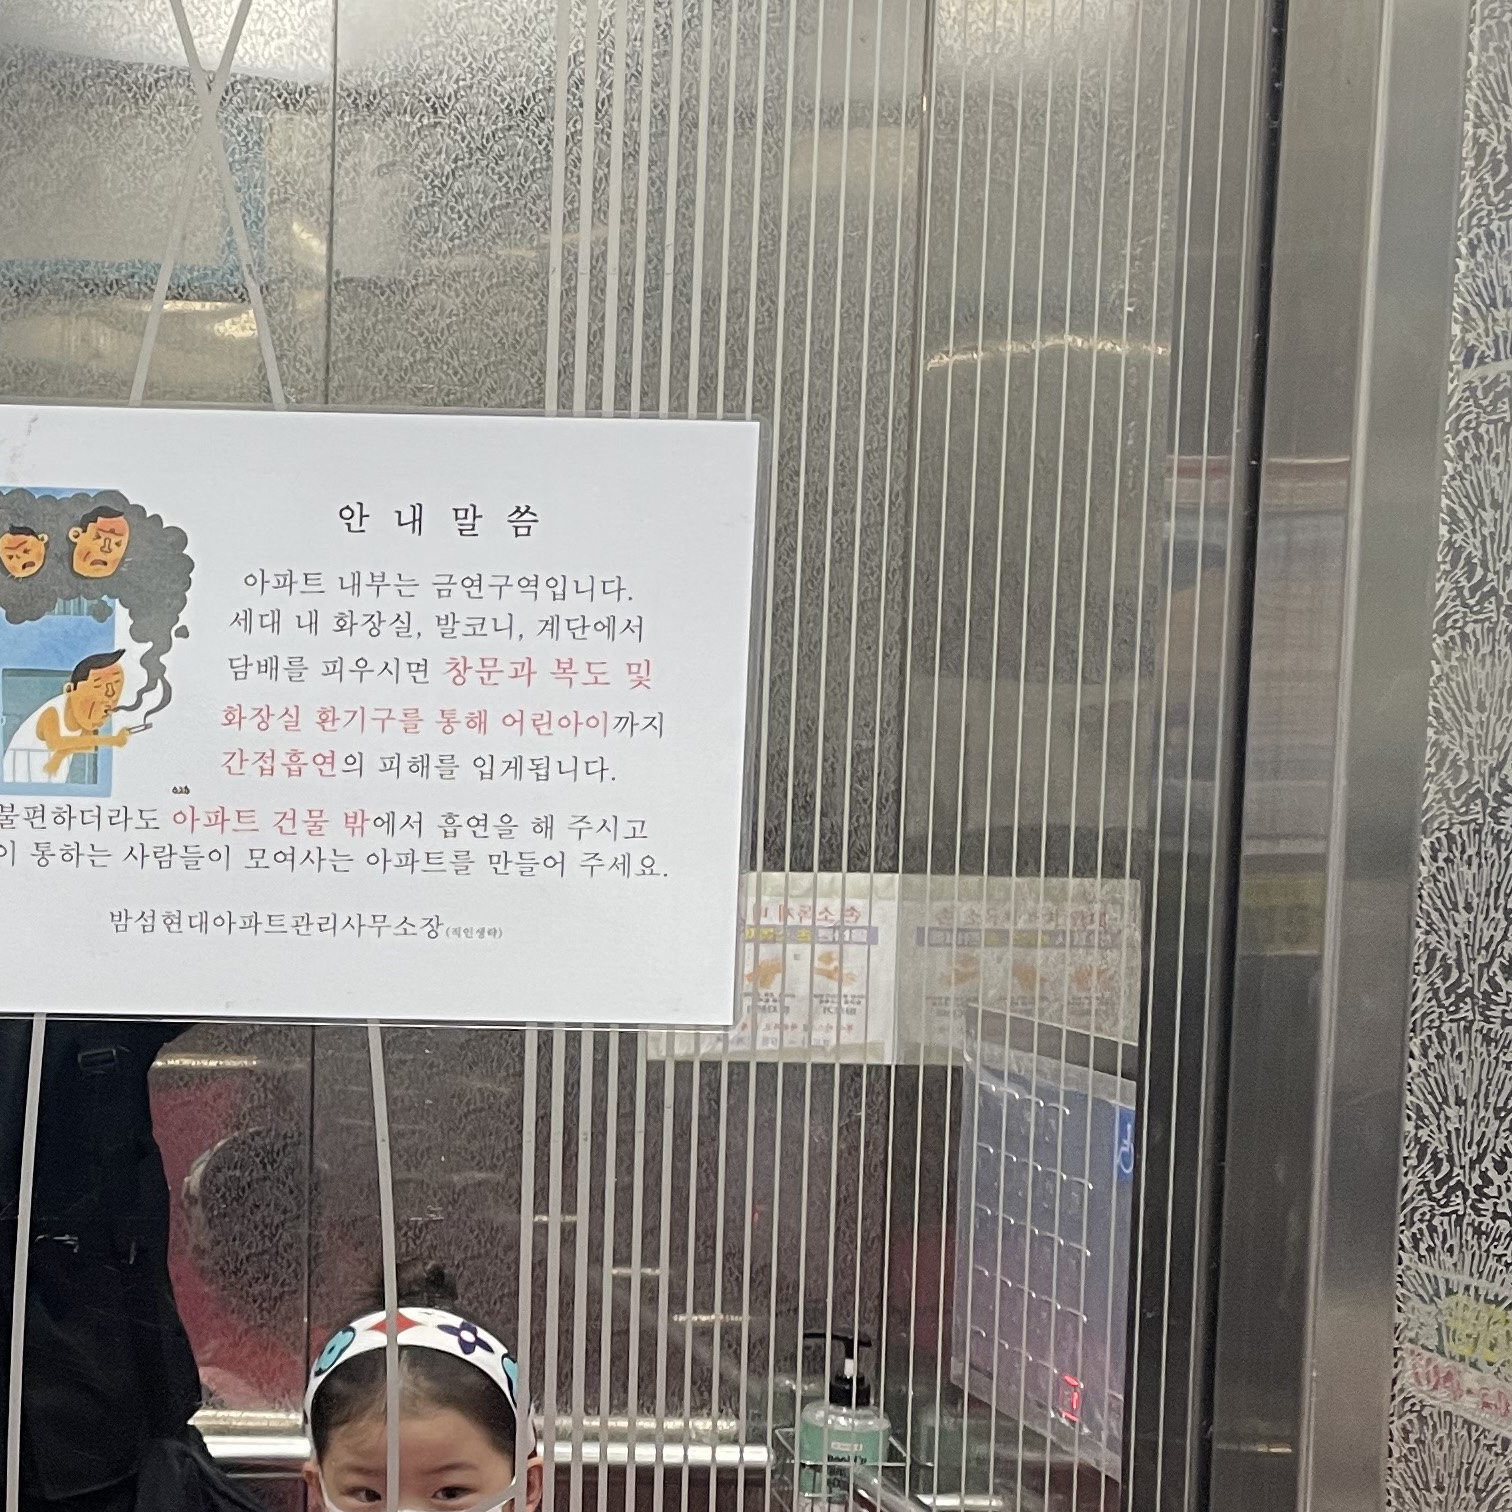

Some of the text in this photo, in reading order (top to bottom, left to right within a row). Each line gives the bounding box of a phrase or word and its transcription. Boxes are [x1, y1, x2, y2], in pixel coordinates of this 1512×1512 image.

[244, 568, 632, 603] 아파트 내부는 금연구역입니다.
[230, 608, 642, 643] 세대 내 화장실, 발코니, 계단에서
[228, 654, 650, 689] 담배를 피우시면 창문과 복도 및
[221, 704, 663, 738] 화장실 환기구를 통해 어린아이까지
[222, 748, 615, 783] 간접흡연의 피해를 입게됩니다.
[173, 805, 259, 834] 아파트
[273, 808, 329, 836] 건물
[344, 809, 422, 838] 밖에서
[437, 812, 518, 839] 흡연을
[531, 814, 553, 840] 해
[568, 815, 648, 841] 주시고
[30, 841, 112, 868] 통하는
[123, 843, 229, 871] 사람들이
[245, 846, 354, 873] 모여사는
[367, 848, 475, 875] 아파트를
[488, 851, 565, 878] 만들어
[580, 852, 667, 878] 주세요.
